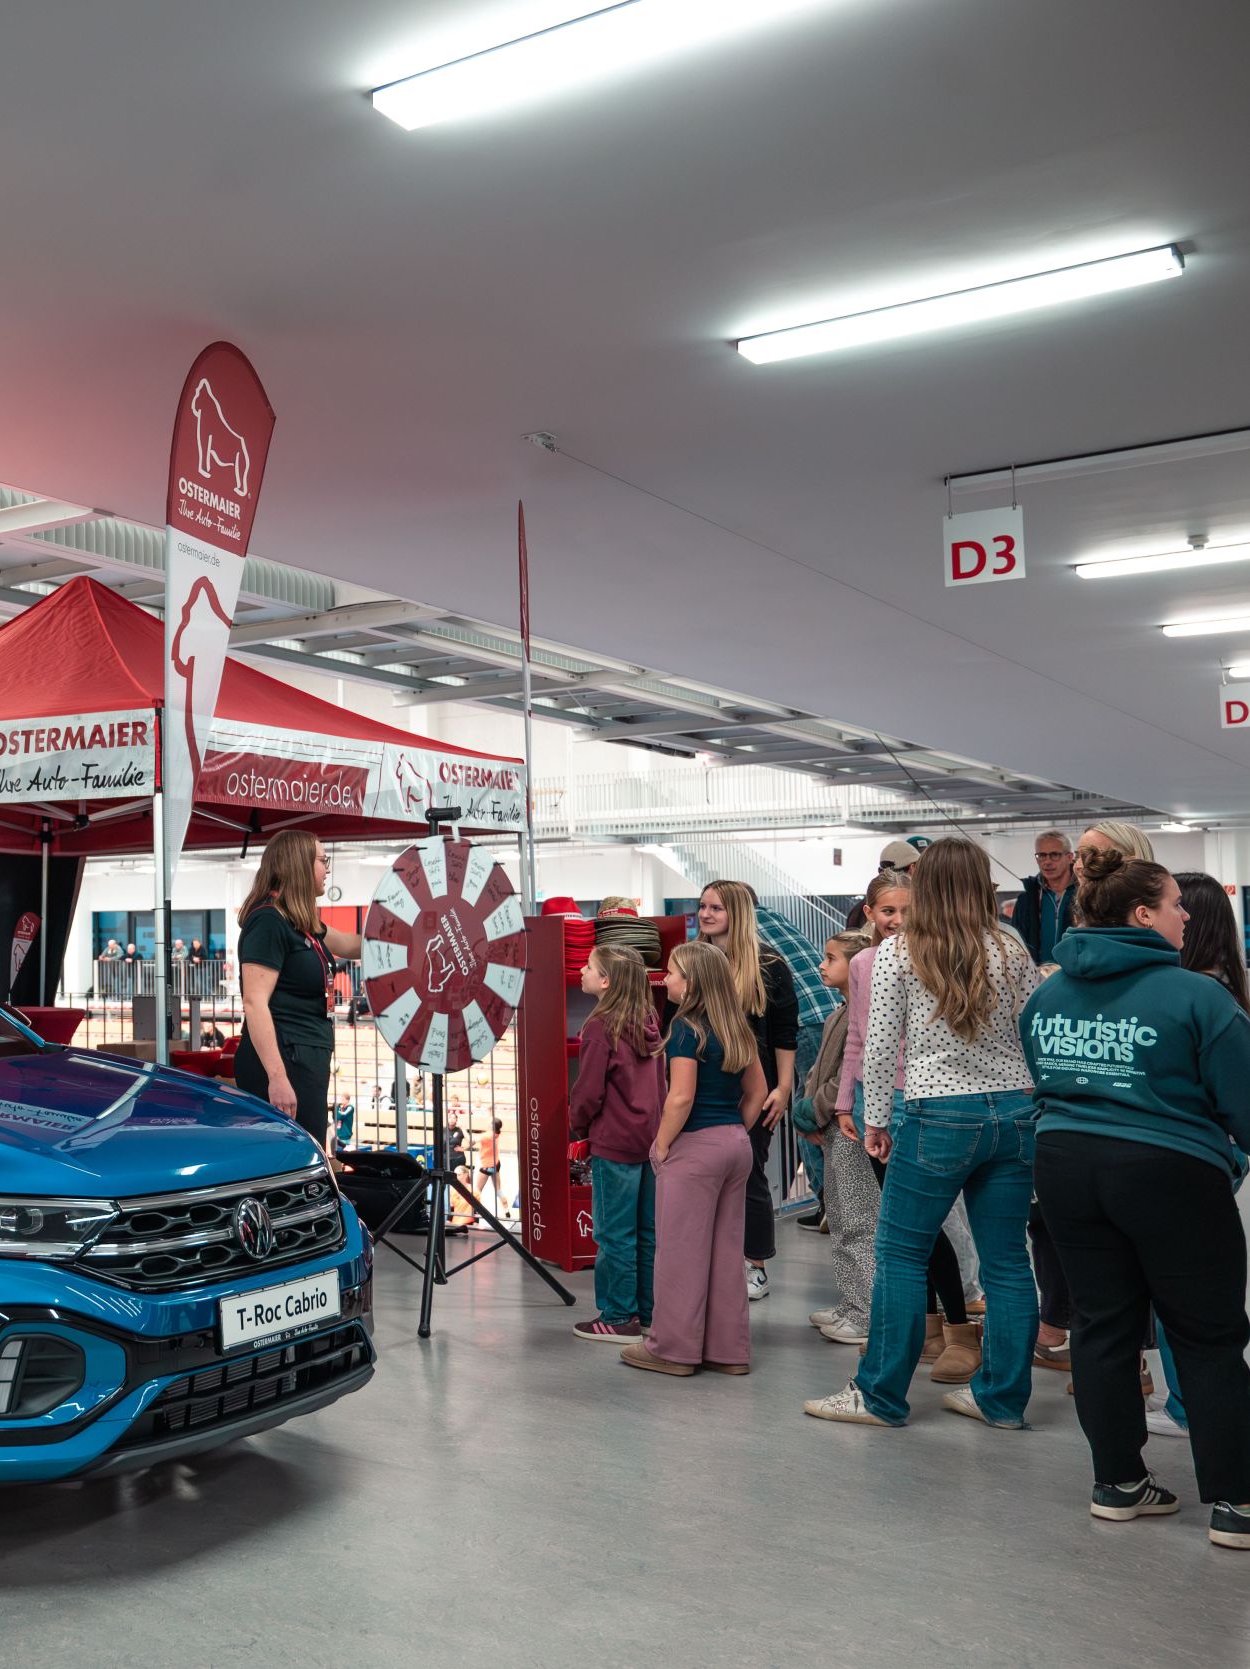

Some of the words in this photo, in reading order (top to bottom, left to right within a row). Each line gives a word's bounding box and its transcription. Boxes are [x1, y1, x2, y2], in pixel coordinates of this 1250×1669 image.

[178, 477, 241, 520] OSTERMAIER
[178, 498, 195, 520] Ihre
[195, 508, 242, 541] Auto-Familie
[177, 542, 221, 568] ostermaier.de
[951, 534, 1017, 580] D3
[1225, 701, 1249, 724] D
[26, 761, 146, 791] Auto-Familie
[226, 771, 352, 807] ostermaier.de
[440, 914, 469, 976] OSTERMAIER
[1031, 1012, 1158, 1047] futuristic
[1039, 1036, 1135, 1063] visions
[530, 1097, 546, 1241] ostermaier.de
[237, 1303, 282, 1330] T-Roc
[285, 1287, 327, 1318] Cabrio
[253, 1333, 282, 1349] OSTERMAIER
